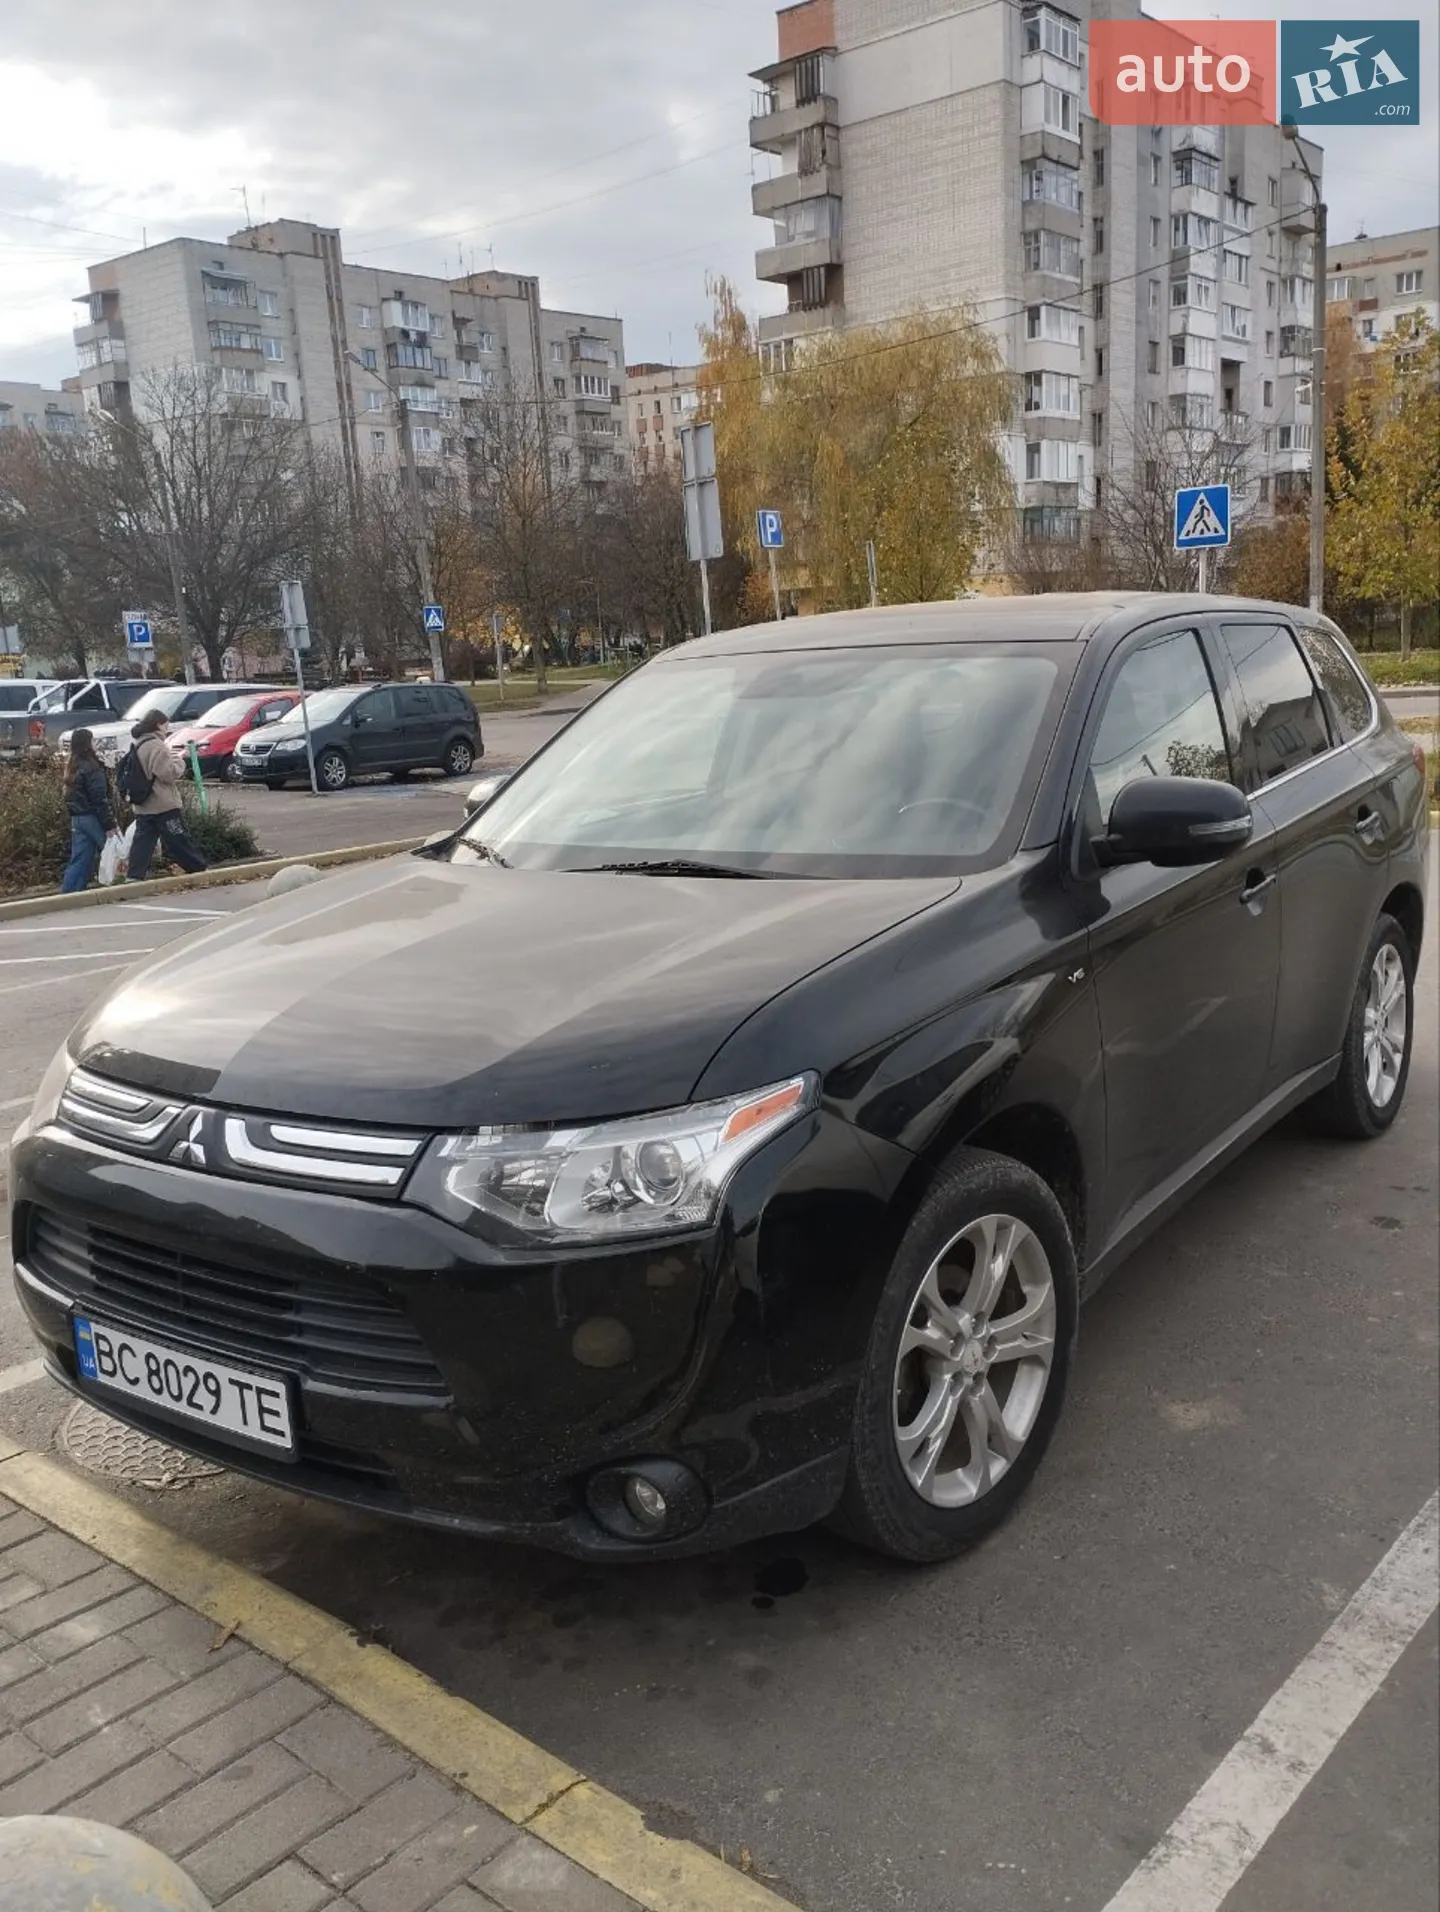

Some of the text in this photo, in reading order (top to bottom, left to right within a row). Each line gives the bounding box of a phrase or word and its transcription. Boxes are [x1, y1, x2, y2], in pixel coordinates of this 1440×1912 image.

[766, 514, 777, 544] P
[132, 624, 146, 641] P
[96, 1332, 286, 1437] BC 8029 TE
